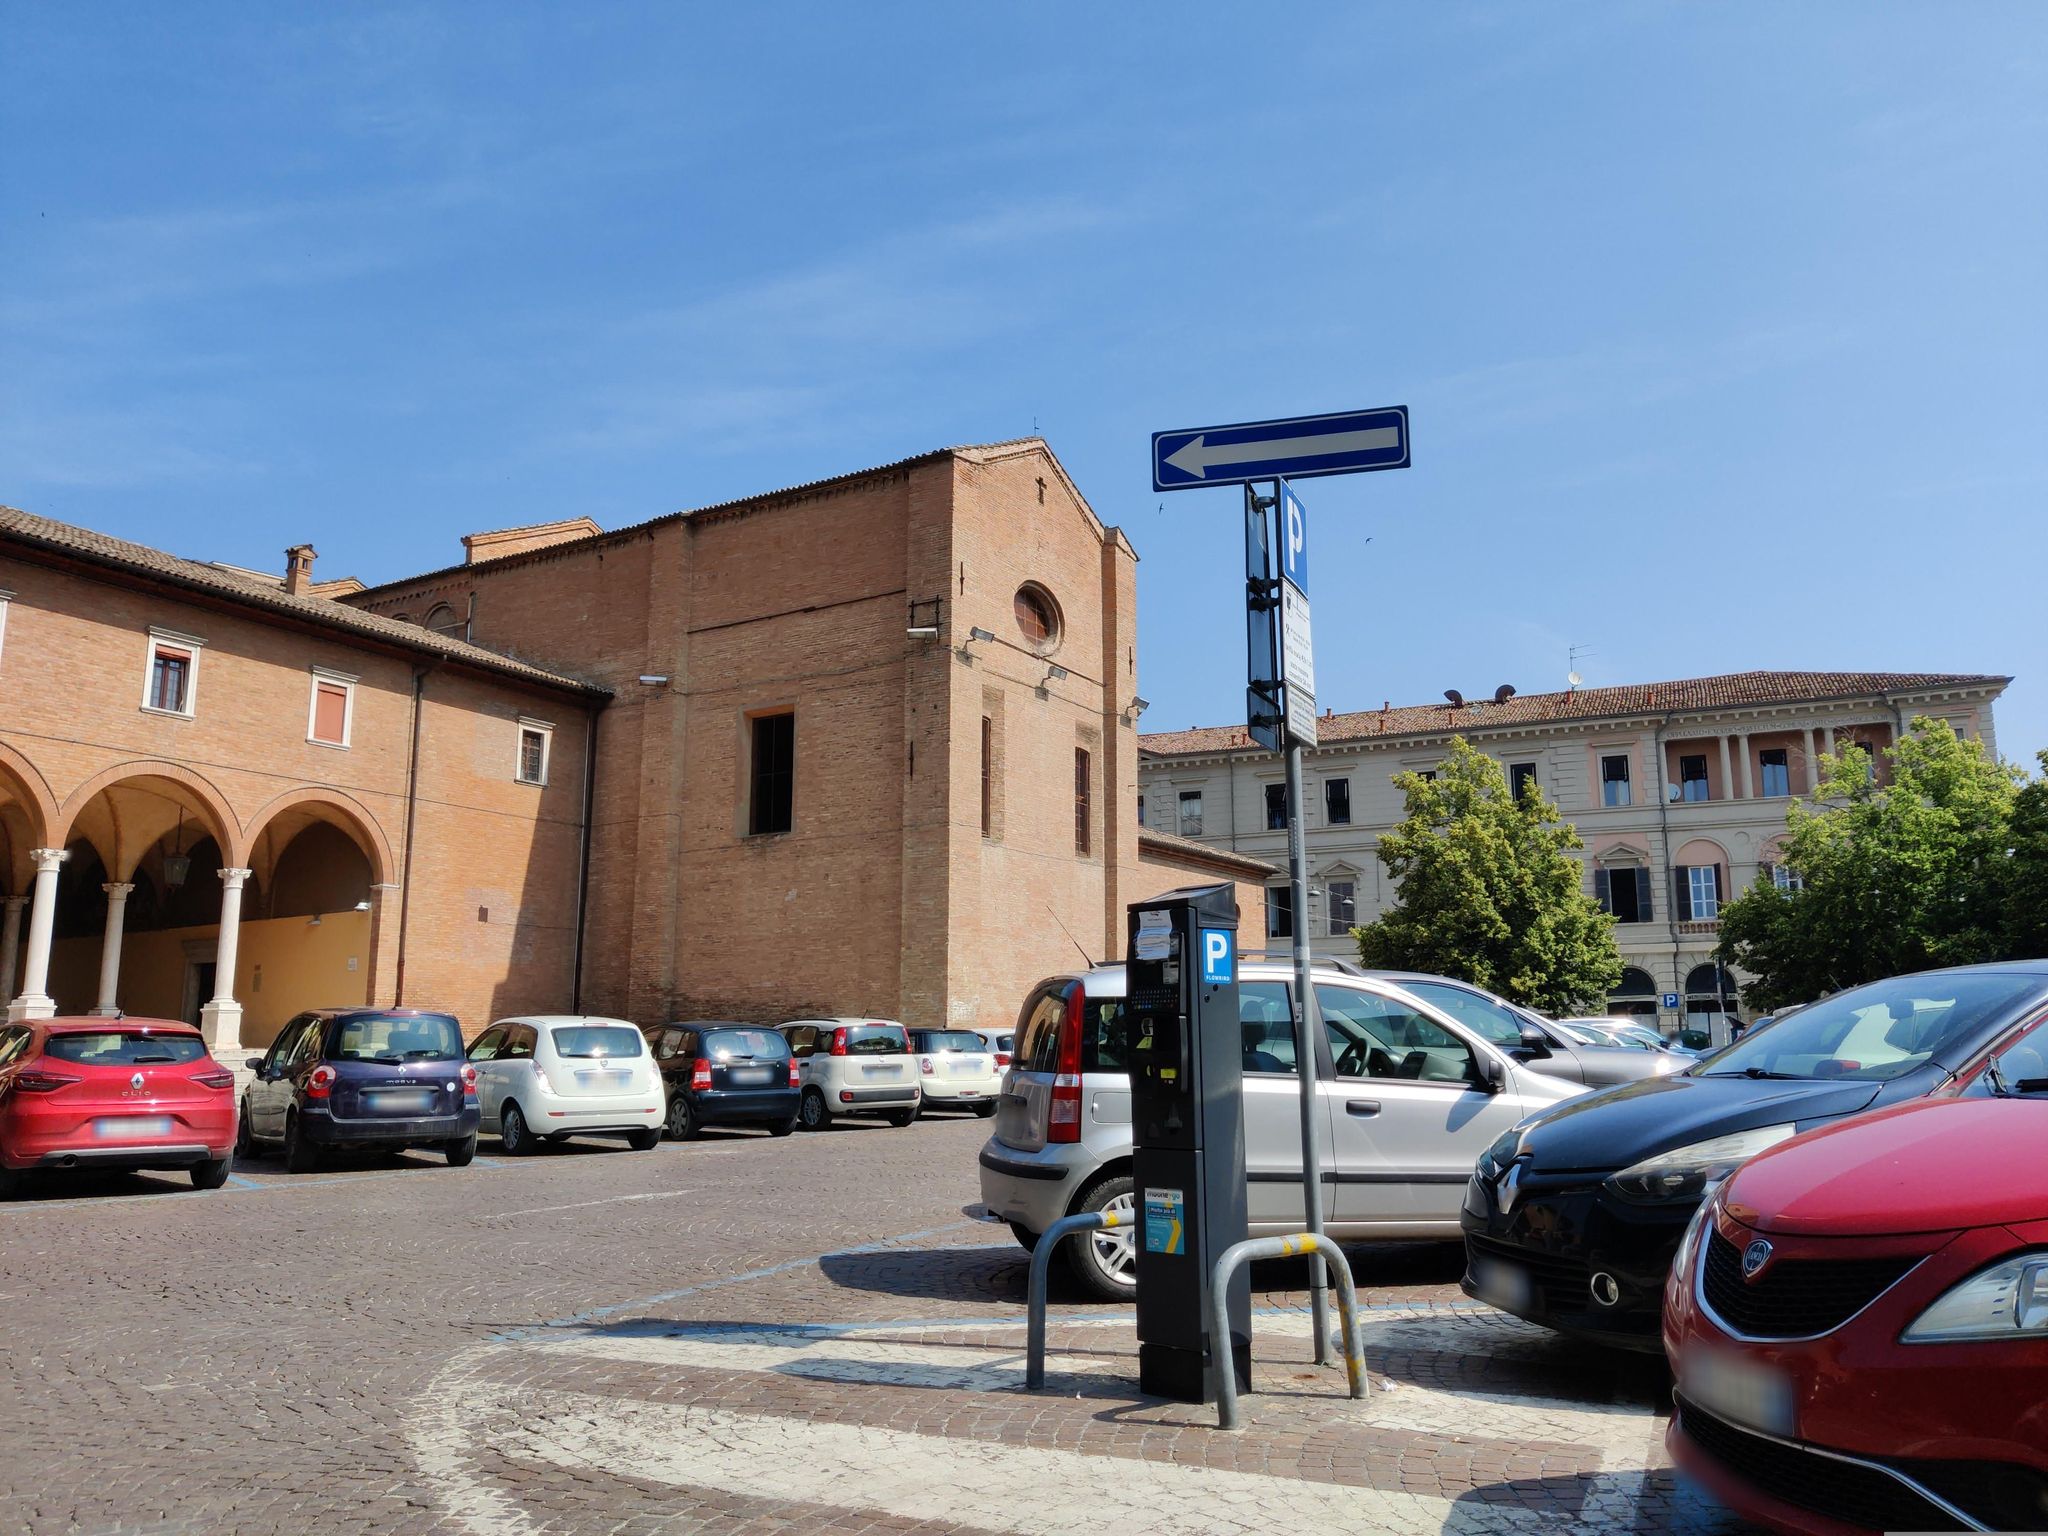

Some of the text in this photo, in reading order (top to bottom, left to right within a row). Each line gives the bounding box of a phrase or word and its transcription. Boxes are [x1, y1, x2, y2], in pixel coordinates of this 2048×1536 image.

[1286, 494, 1303, 573] P
[1206, 933, 1227, 973] P
[1666, 995, 1676, 1007] P
